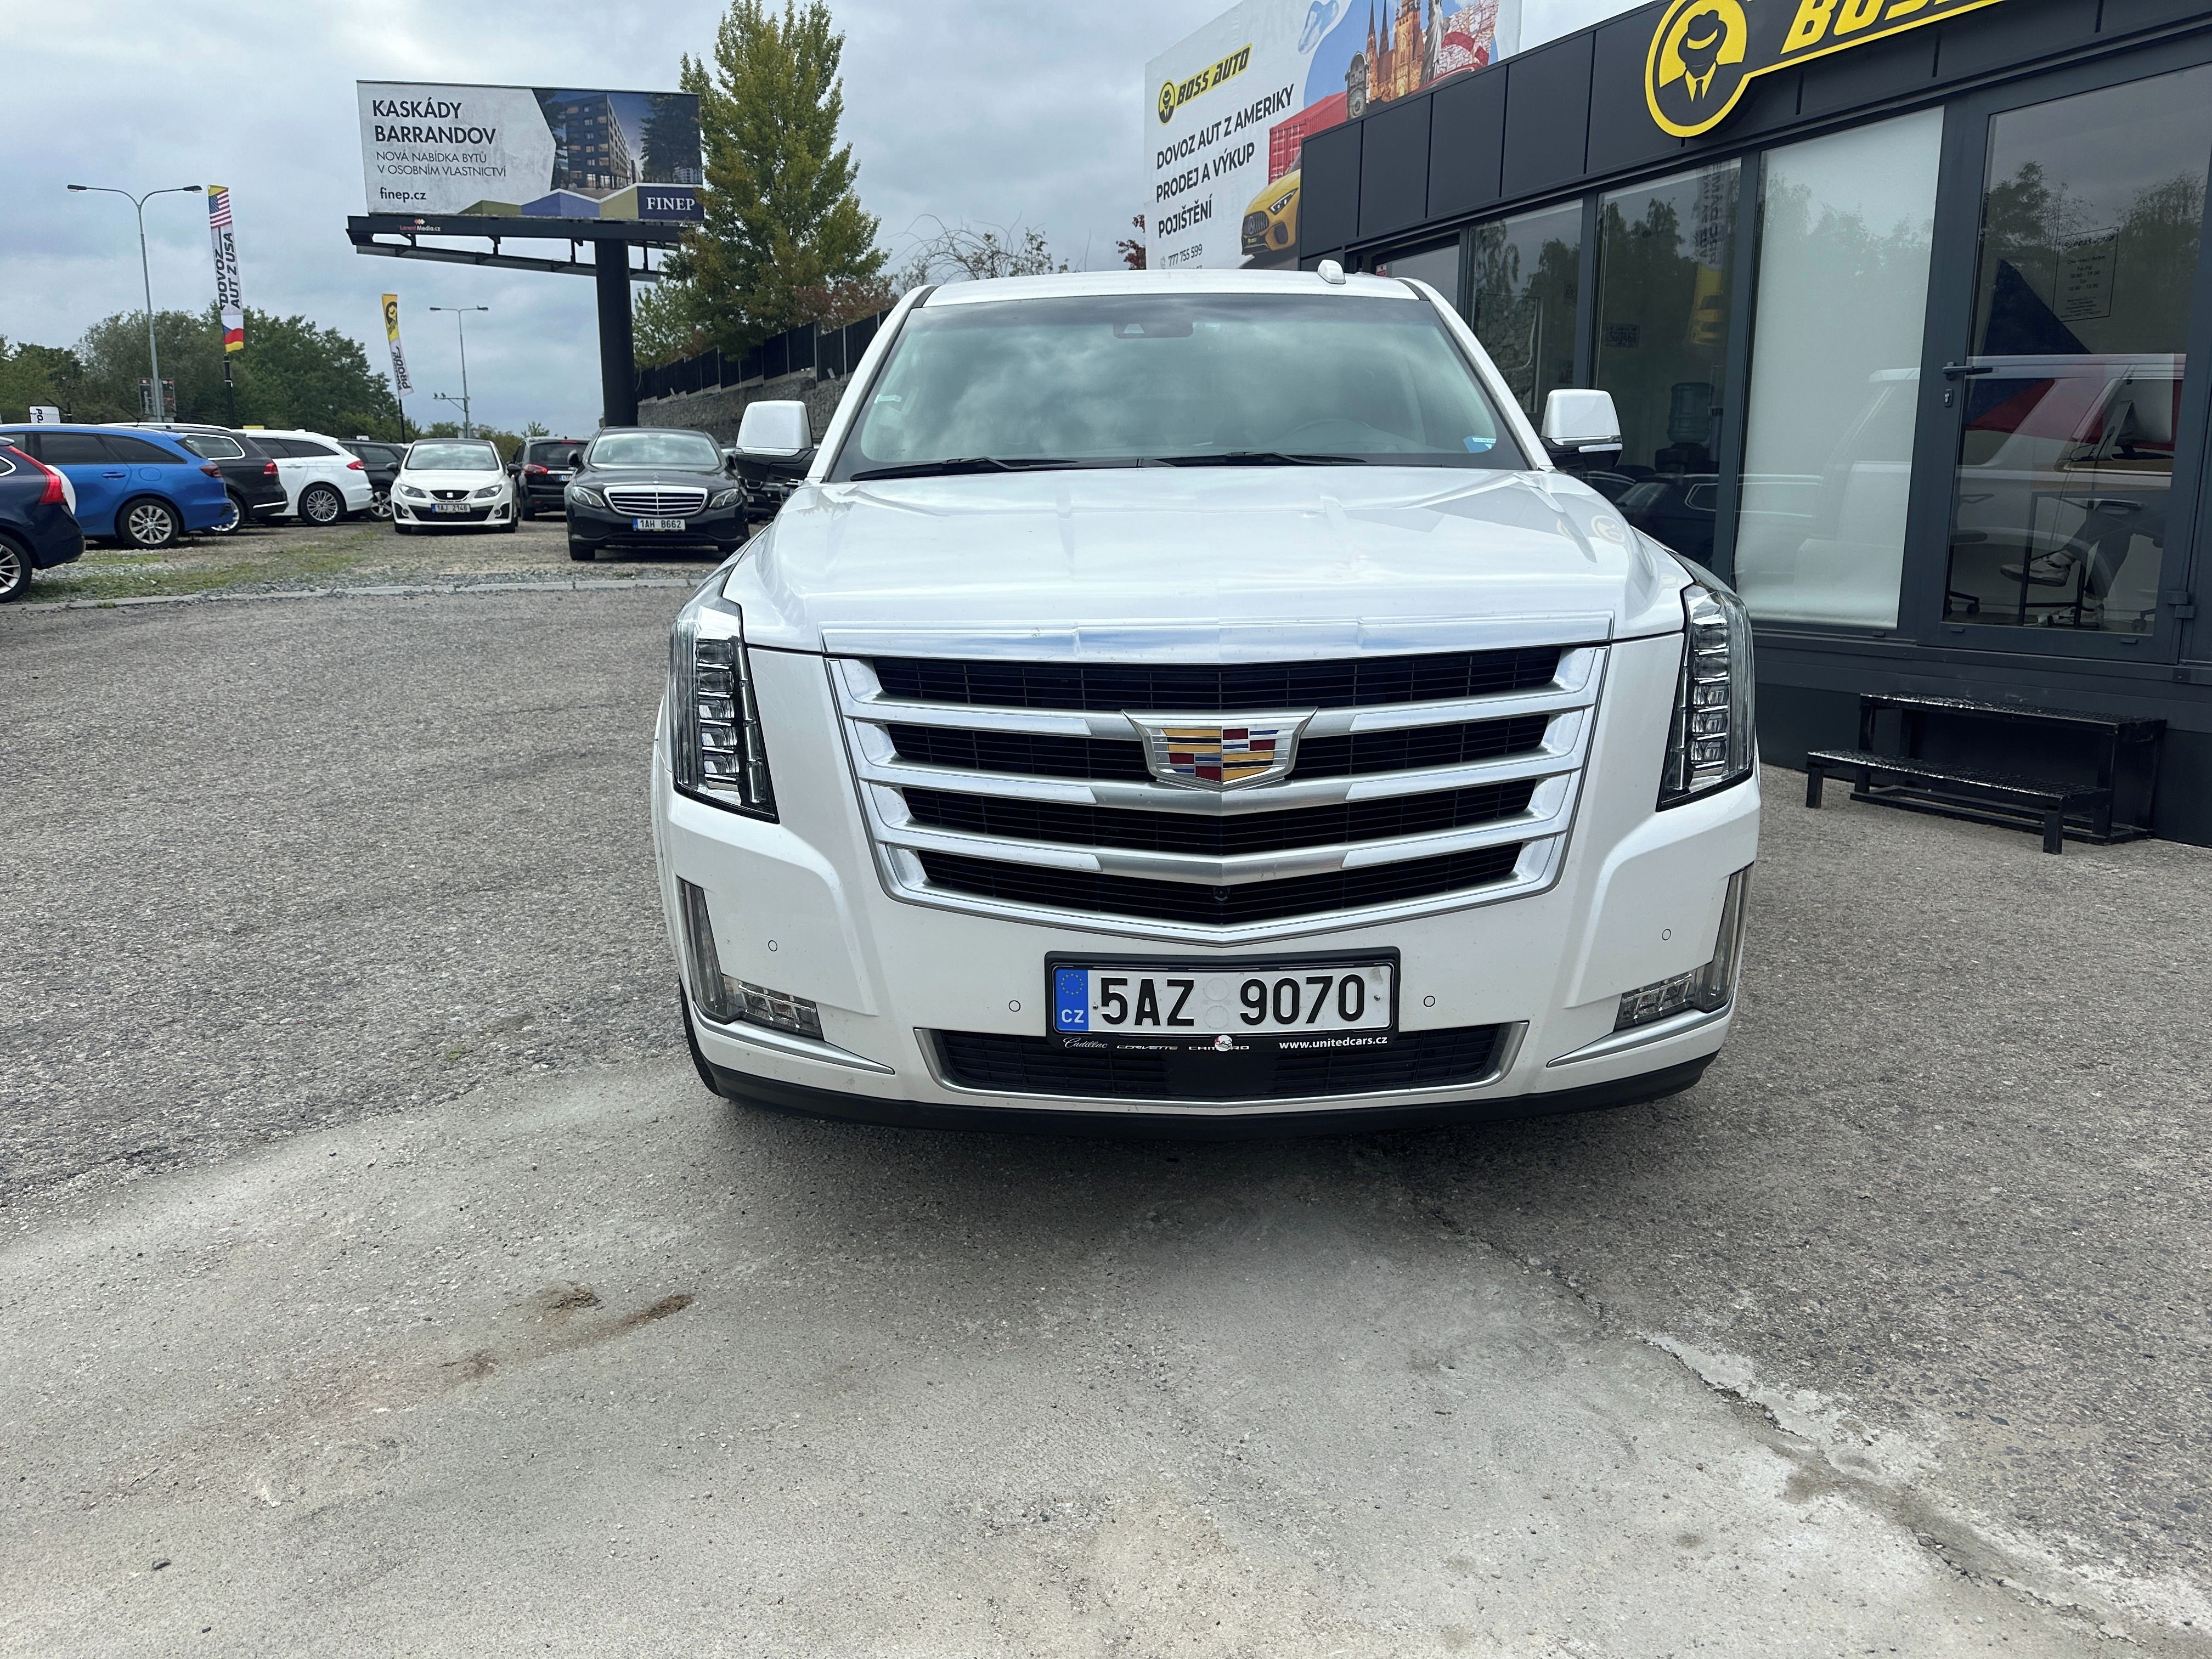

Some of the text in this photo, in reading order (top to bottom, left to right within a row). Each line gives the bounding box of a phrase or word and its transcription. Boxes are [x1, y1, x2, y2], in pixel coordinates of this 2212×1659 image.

[1176, 47, 1250, 106] BOSS AUTO
[373, 97, 462, 119] KASKÁDY
[375, 125, 496, 144] BARRANDOV
[1157, 83, 1294, 170] DOVOZ AUT Z AMERIKY
[376, 149, 487, 163] NOVÁ NABÍDKA BYTŮ
[377, 163, 506, 177] V OSOBNÍM VLASTNICTVÍ
[1156, 142, 1255, 203] PRODEJ A VÝKUP
[380, 187, 427, 202] finep.cz
[646, 197, 695, 211] FINEP
[1159, 193, 1212, 238] POJIŠTĚNÍ
[1168, 244, 1203, 267] 777 755 599
[215, 249, 228, 305] DOVOZ
[223, 233, 240, 309] AUT Z USA
[640, 520, 655, 528] 1AH
[1062, 974, 1365, 1026] CZ 5AZ 9070
[1063, 1037, 1108, 1048] Cadillac
[1279, 1036, 1387, 1049] www.unitedcars.cz
